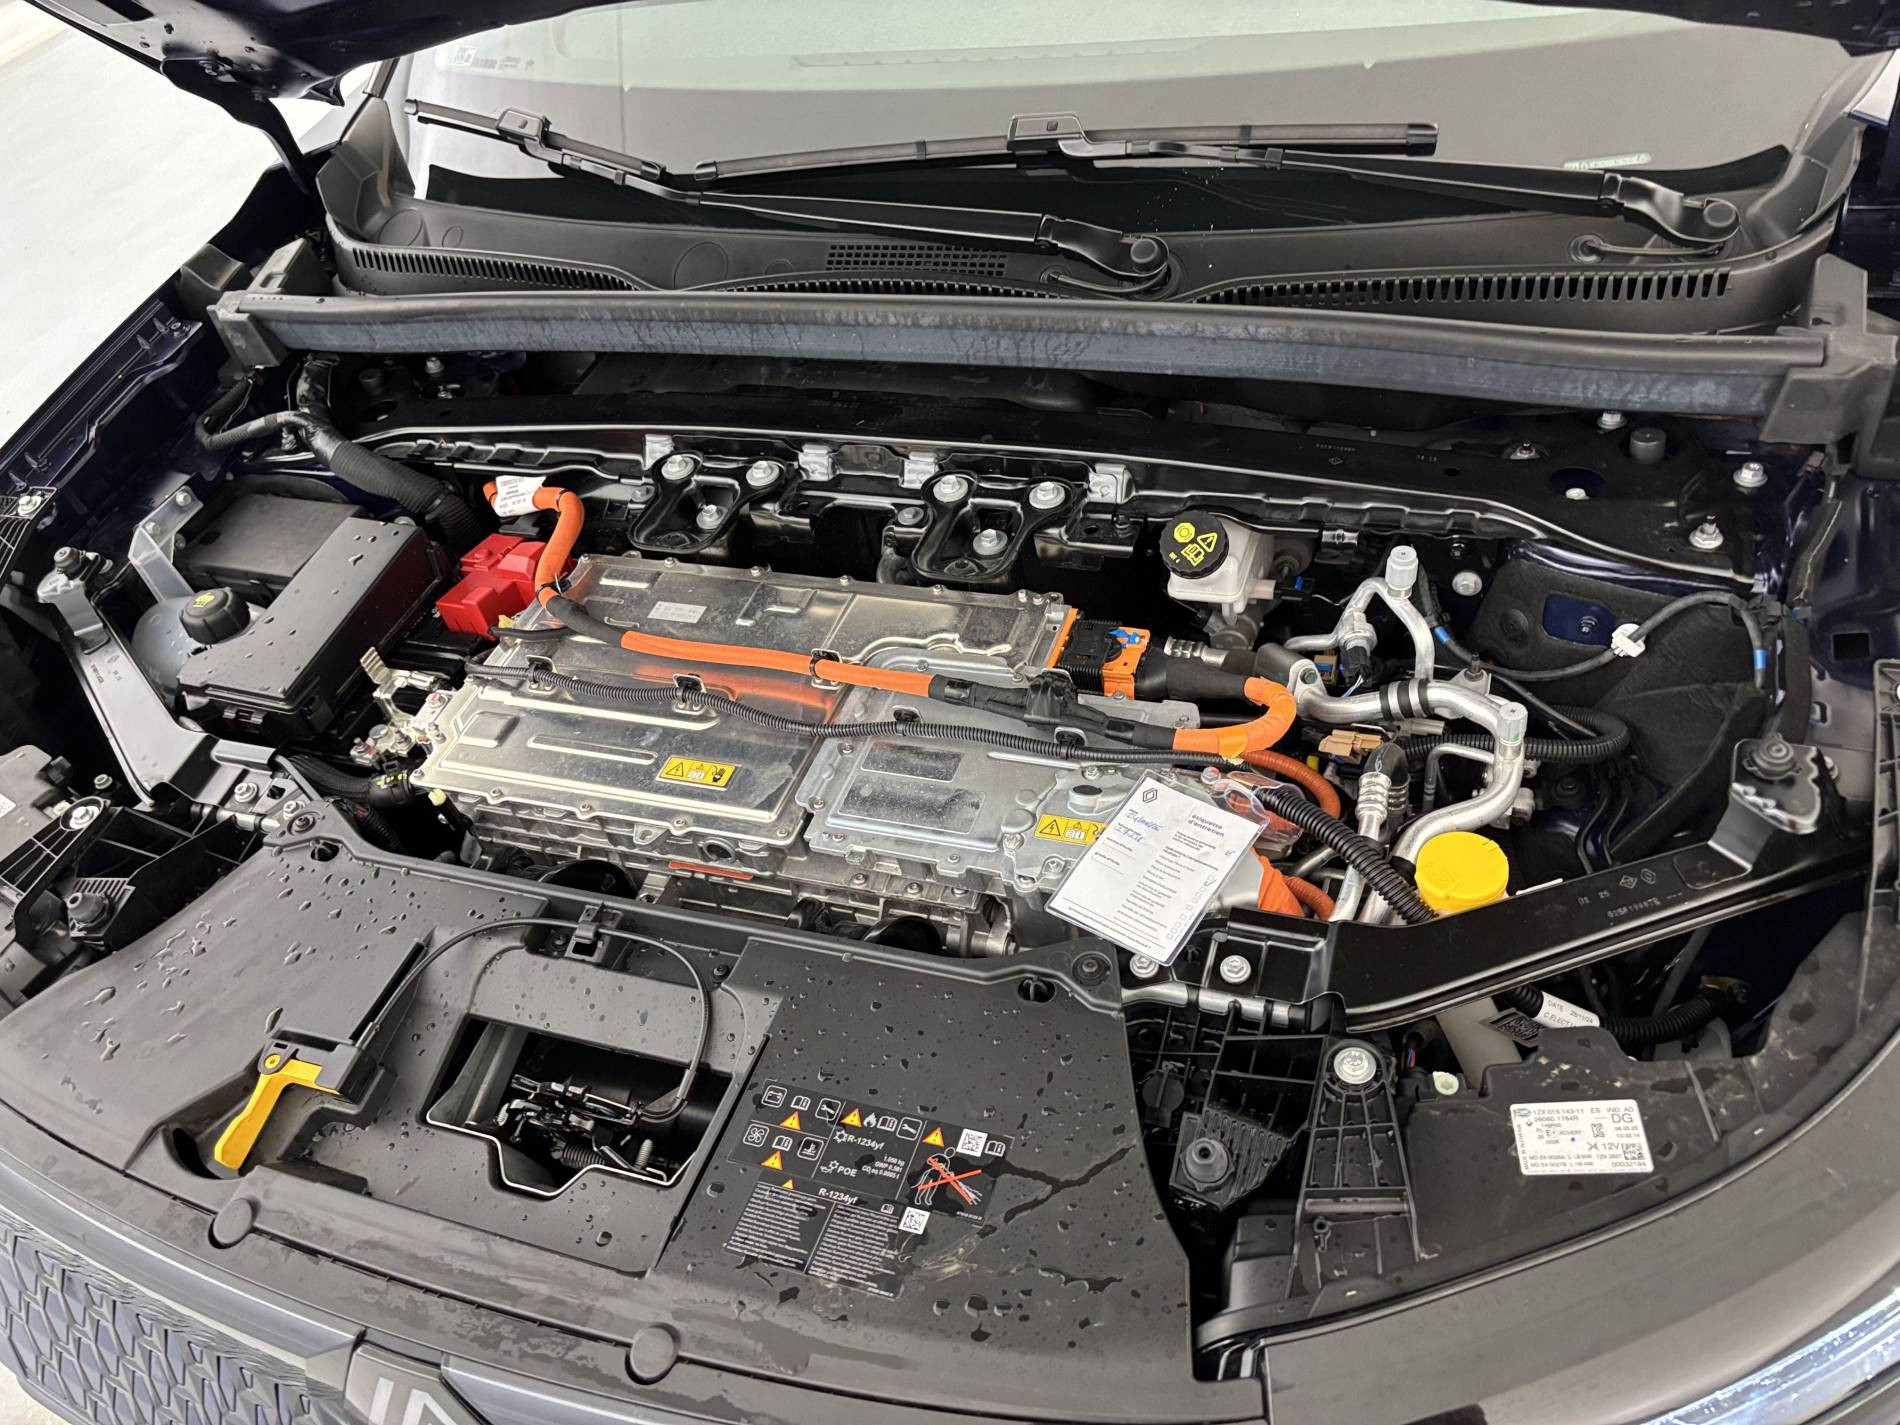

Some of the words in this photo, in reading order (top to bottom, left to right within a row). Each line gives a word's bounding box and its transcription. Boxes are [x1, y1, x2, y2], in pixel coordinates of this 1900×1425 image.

[1548, 1000, 1564, 1012] DATE
[1611, 1113, 1633, 1123] DG
[846, 1133, 885, 1150] R-1234yf
[1602, 1142, 1619, 1150] 12V
[837, 1165, 858, 1177] POE
[818, 1187, 858, 1204] R-1234yf
